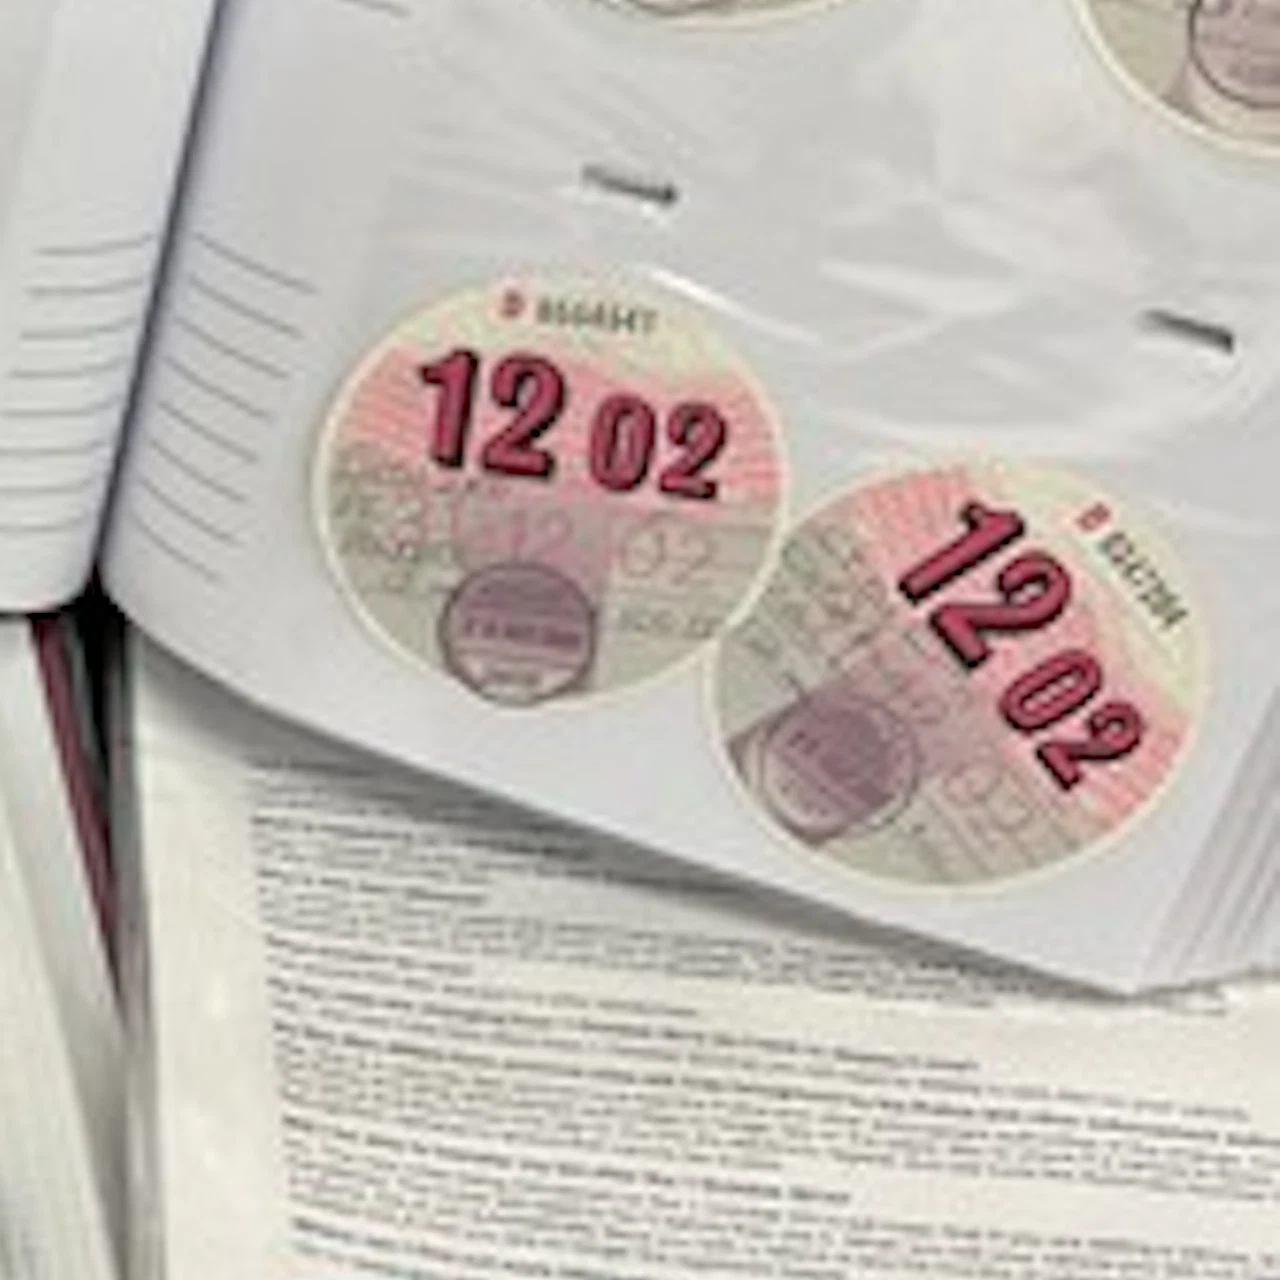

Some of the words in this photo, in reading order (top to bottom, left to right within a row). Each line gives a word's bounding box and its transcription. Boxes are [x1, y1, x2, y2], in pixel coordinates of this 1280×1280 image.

[419, 347, 566, 480] 12
[590, 393, 729, 502] 02
[899, 500, 1073, 671] 12
[998, 649, 1147, 793] 02
